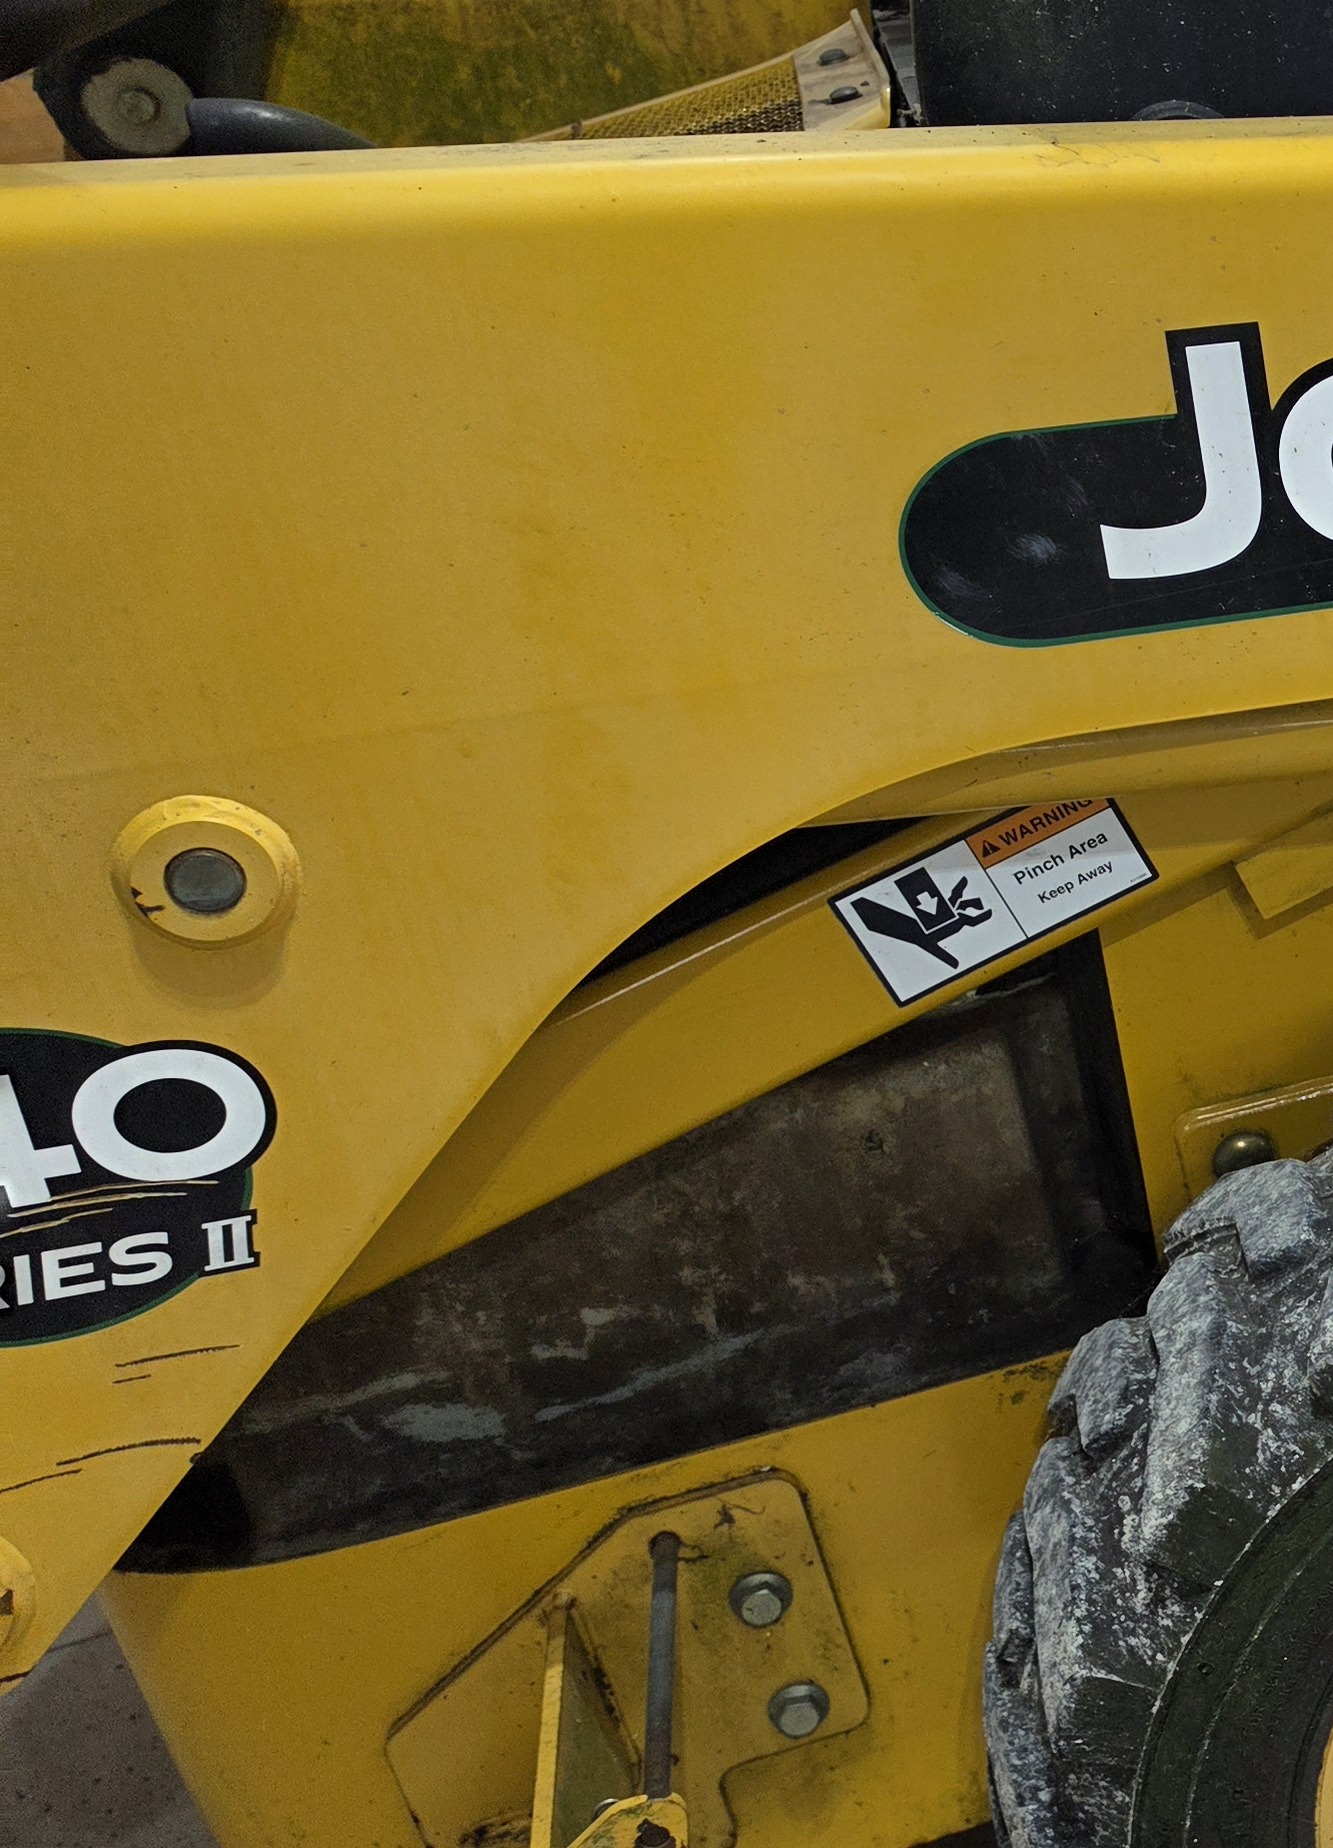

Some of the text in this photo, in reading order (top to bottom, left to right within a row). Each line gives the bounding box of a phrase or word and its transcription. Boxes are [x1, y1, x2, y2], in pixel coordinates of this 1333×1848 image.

[1013, 833, 1108, 885] Pinch Area
[1037, 881, 1075, 903] Keep
[1077, 861, 1112, 885] Away
[0, 1215, 255, 1310] IES II
